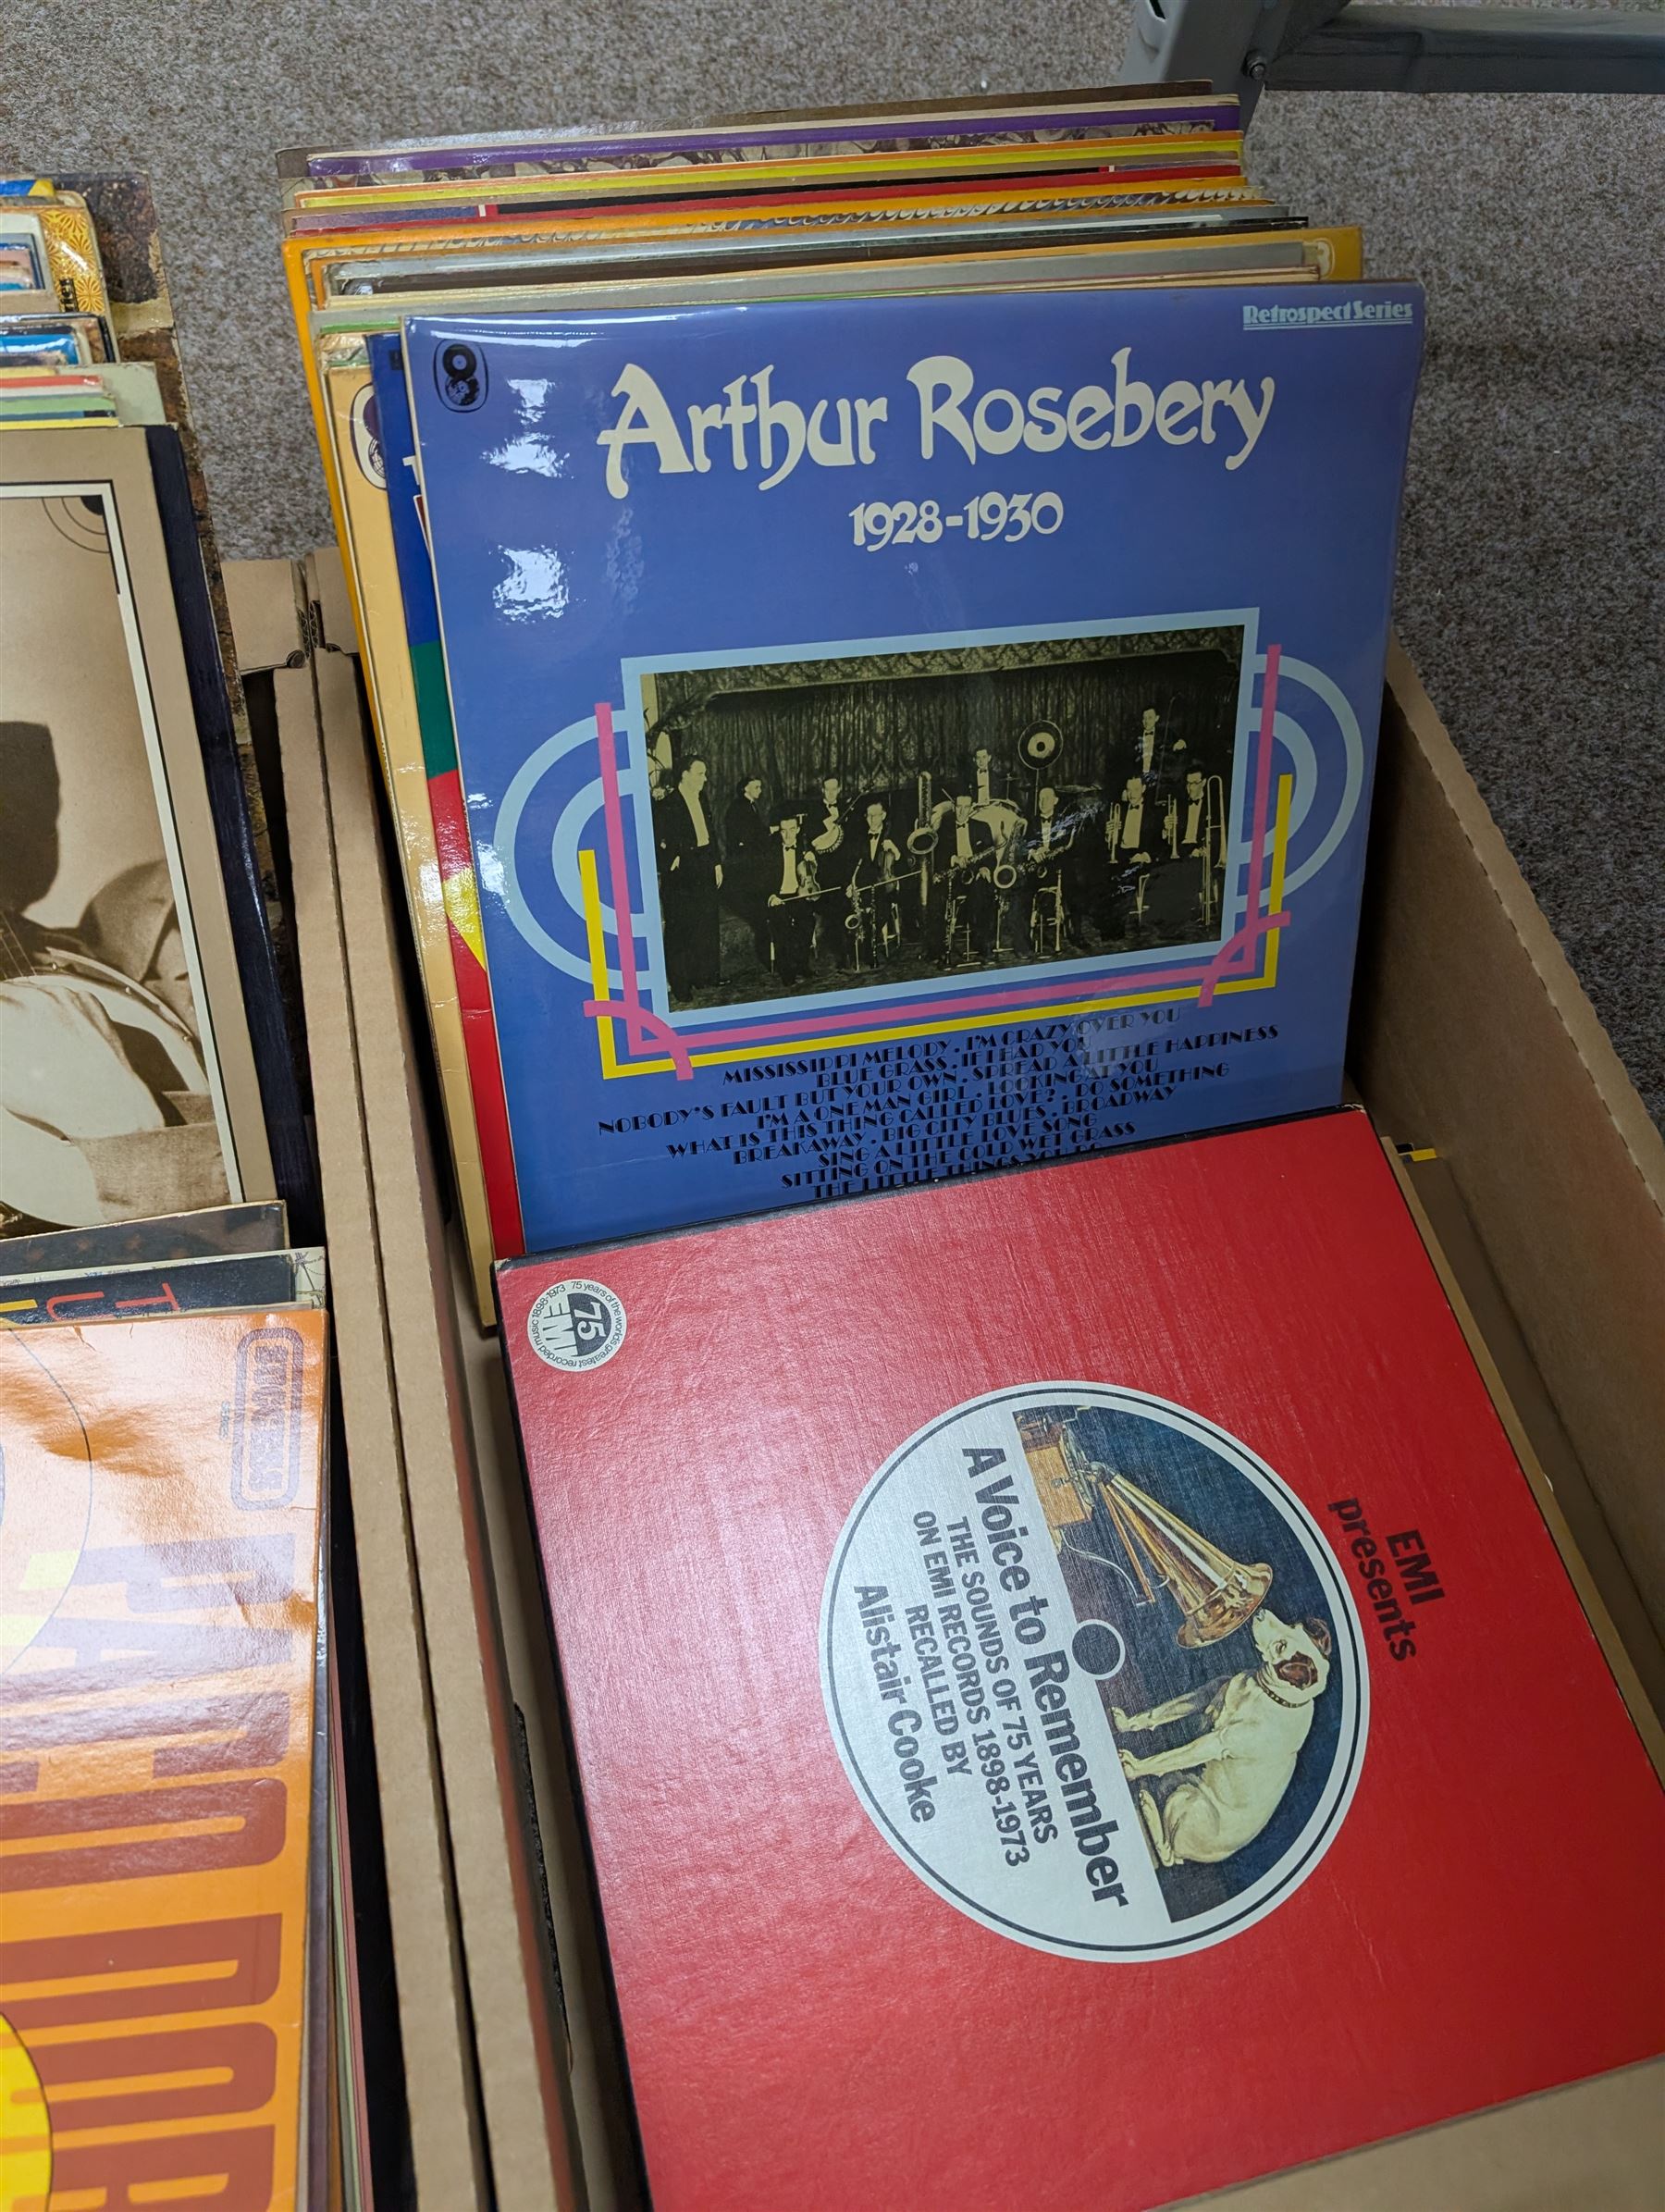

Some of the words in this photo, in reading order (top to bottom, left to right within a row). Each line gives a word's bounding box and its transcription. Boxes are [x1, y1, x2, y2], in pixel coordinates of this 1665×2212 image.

[598, 363, 888, 500] Arthur
[906, 346, 1276, 471] Rosebery
[847, 490, 1065, 552] 1928-1930
[722, 1053, 857, 1086] MISSISSIPPI
[862, 1039, 952, 1065] MELODY
[966, 1032, 998, 1052] I'M
[1001, 1023, 1073, 1046] CRAZY
[1077, 1013, 1135, 1036] OVER
[1140, 1007, 1181, 1026] YOU
[815, 1067, 874, 1089] BLUE
[880, 1056, 948, 1080] GRASS
[963, 1051, 981, 1068] IF
[998, 1043, 1044, 1063] HAD
[1048, 1035, 1092, 1054] YOU
[597, 1105, 716, 1137] NOBODY'S
[720, 1094, 789, 1118] FAULT
[795, 1088, 837, 1107] BUT
[843, 1079, 902, 1100] YOUR
[907, 1072, 957, 1092] OWN
[972, 1057, 1057, 1081] SPREAD
[1065, 1054, 1079, 1068] A
[1082, 1043, 1160, 1067] LITTLE
[1165, 1023, 1280, 1055] HAPPINESS
[756, 1108, 790, 1130] I'M
[794, 1109, 810, 1125] A
[814, 1100, 861, 1122] ONE
[862, 1094, 912, 1113] MAN
[917, 1084, 969, 1106] GIRL
[988, 1070, 1082, 1094] LOOKING
[1085, 1063, 1110, 1080] AT
[1116, 1058, 1159, 1077] YOU
[666, 1134, 734, 1159] WHAT
[738, 1130, 761, 1149] IS
[766, 1122, 819, 1144] THIS
[821, 1112, 894, 1136] THING
[897, 1097, 983, 1124] CALLED
[988, 1088, 1056, 1113] LOVE?
[1075, 1080, 1104, 1098] DO
[1109, 1062, 1230, 1094] SOMETHING
[733, 1131, 867, 1165] BREAKAWAY
[880, 1124, 923, 1143] BIG
[925, 1115, 977, 1137] CITY
[980, 1105, 1047, 1129] BLUES
[1061, 1085, 1178, 1117] BROADWAY
[780, 1162, 870, 1190] SITTING
[873, 1156, 904, 1176] ON
[906, 1149, 955, 1170] THE
[958, 1140, 1015, 1162] COLD
[1018, 1131, 1065, 1152] WET
[1069, 1120, 1138, 1144] GRASS
[817, 1146, 870, 1168] SING
[874, 1144, 892, 1159] A
[894, 1131, 974, 1156] LITTLE
[980, 1121, 1037, 1144] LOVE
[1041, 1113, 1098, 1133] SONG
[532, 1283, 566, 1318] 1898-1973
[571, 1280, 584, 1290] 75
[583, 1282, 608, 1298] years
[605, 1295, 617, 1304] of
[610, 1302, 622, 1316] the
[531, 1319, 543, 1346] music
[574, 1301, 607, 1341] 75
[537, 1344, 577, 1367] recorded
[578, 1343, 613, 1368] greatest
[962, 1447, 1007, 1478] A
[913, 1510, 943, 1548] ON
[946, 1515, 980, 1569] THE
[974, 1474, 1030, 1593] Voice
[922, 1550, 956, 1599] EMI
[1327, 1497, 1417, 1662] presents
[1386, 1528, 1445, 1605] EMI
[961, 1570, 1010, 1674] SOUNDS
[1008, 1594, 1050, 1646] to
[904, 1603, 960, 1736] RECALLED
[940, 1739, 973, 1775] BY
[937, 1602, 992, 1725] RECORDS
[853, 1585, 913, 1705] Alistair
[886, 1708, 939, 1823] Cooke
[992, 1678, 1023, 1715] OF
[1002, 1715, 1032, 1751] 75
[971, 1728, 1030, 1868] 1898-1973
[1013, 1750, 1058, 1845] YEARS
[1023, 1649, 1129, 1908] Remember
